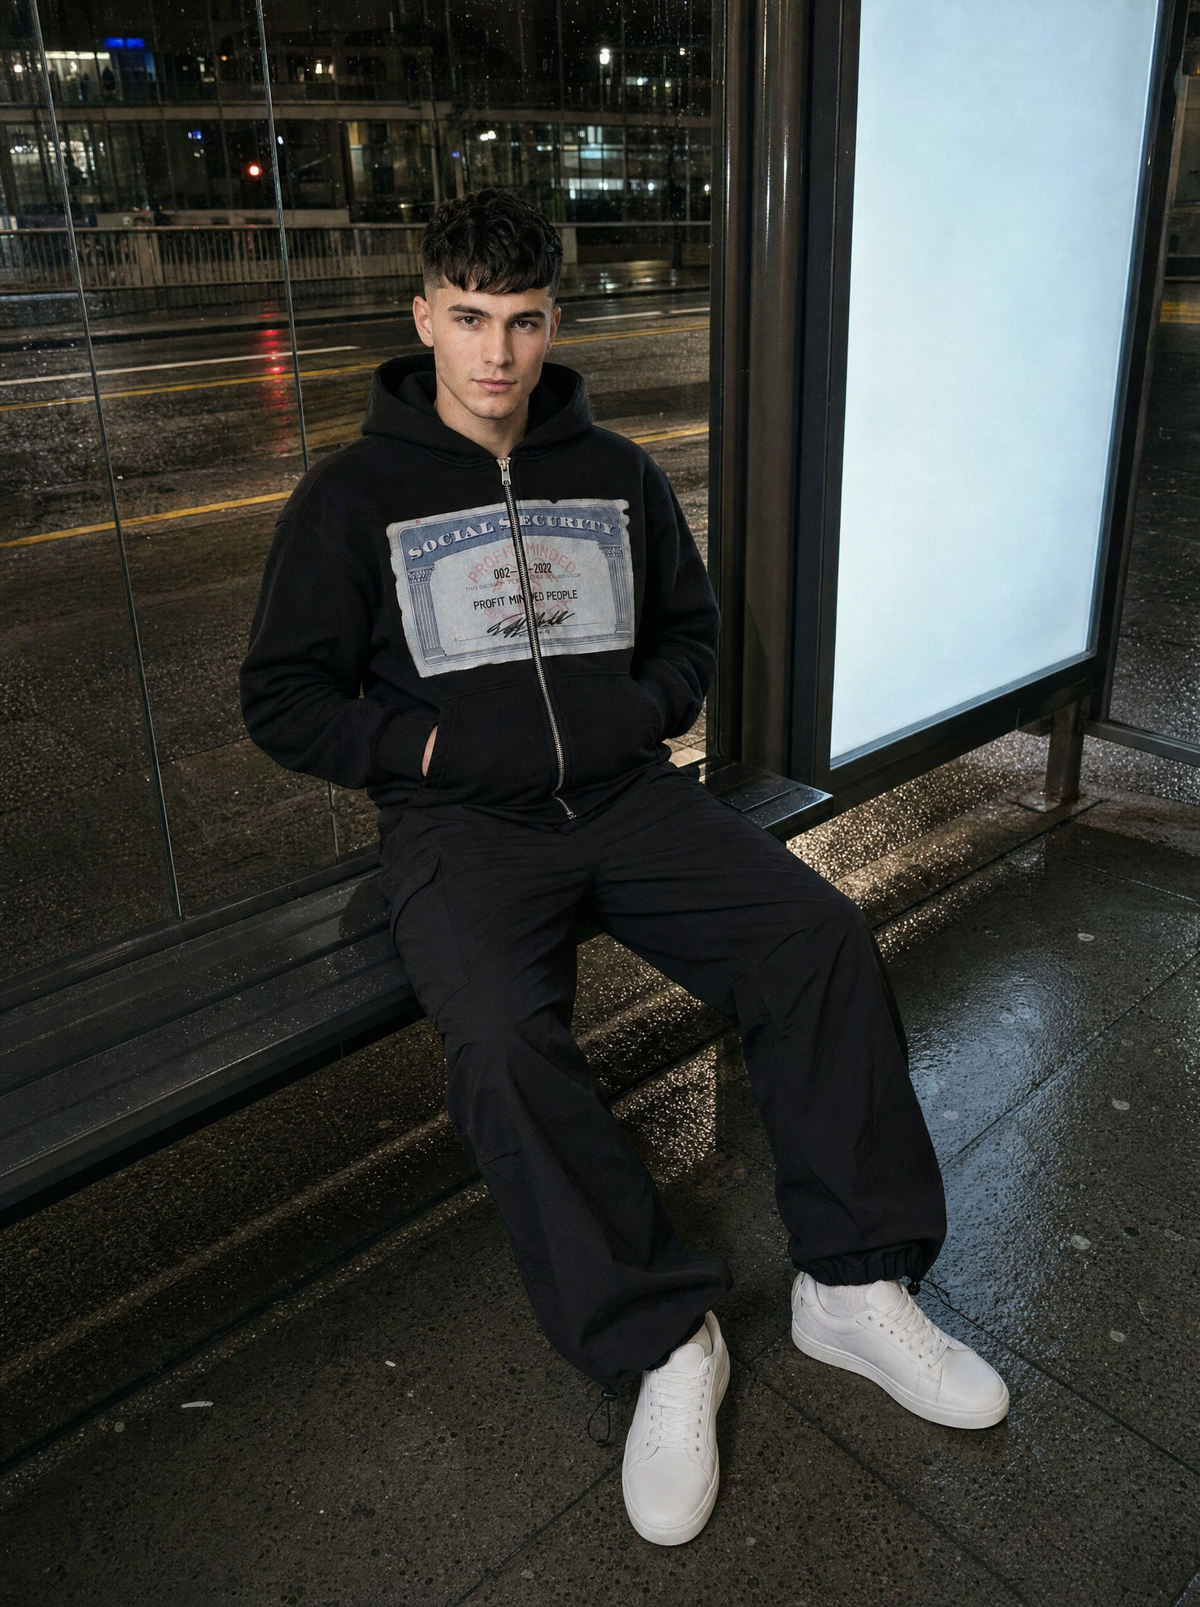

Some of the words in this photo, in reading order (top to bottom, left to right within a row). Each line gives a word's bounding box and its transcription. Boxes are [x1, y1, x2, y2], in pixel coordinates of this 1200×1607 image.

[408, 521, 496, 561] SOCIAL
[498, 515, 617, 537] SECURITY
[467, 545, 515, 584] PROFIT
[526, 542, 577, 574] MINDED
[473, 596, 506, 611] PROFIT
[508, 591, 545, 606] MINED
[546, 589, 579, 601] PEOPLE
